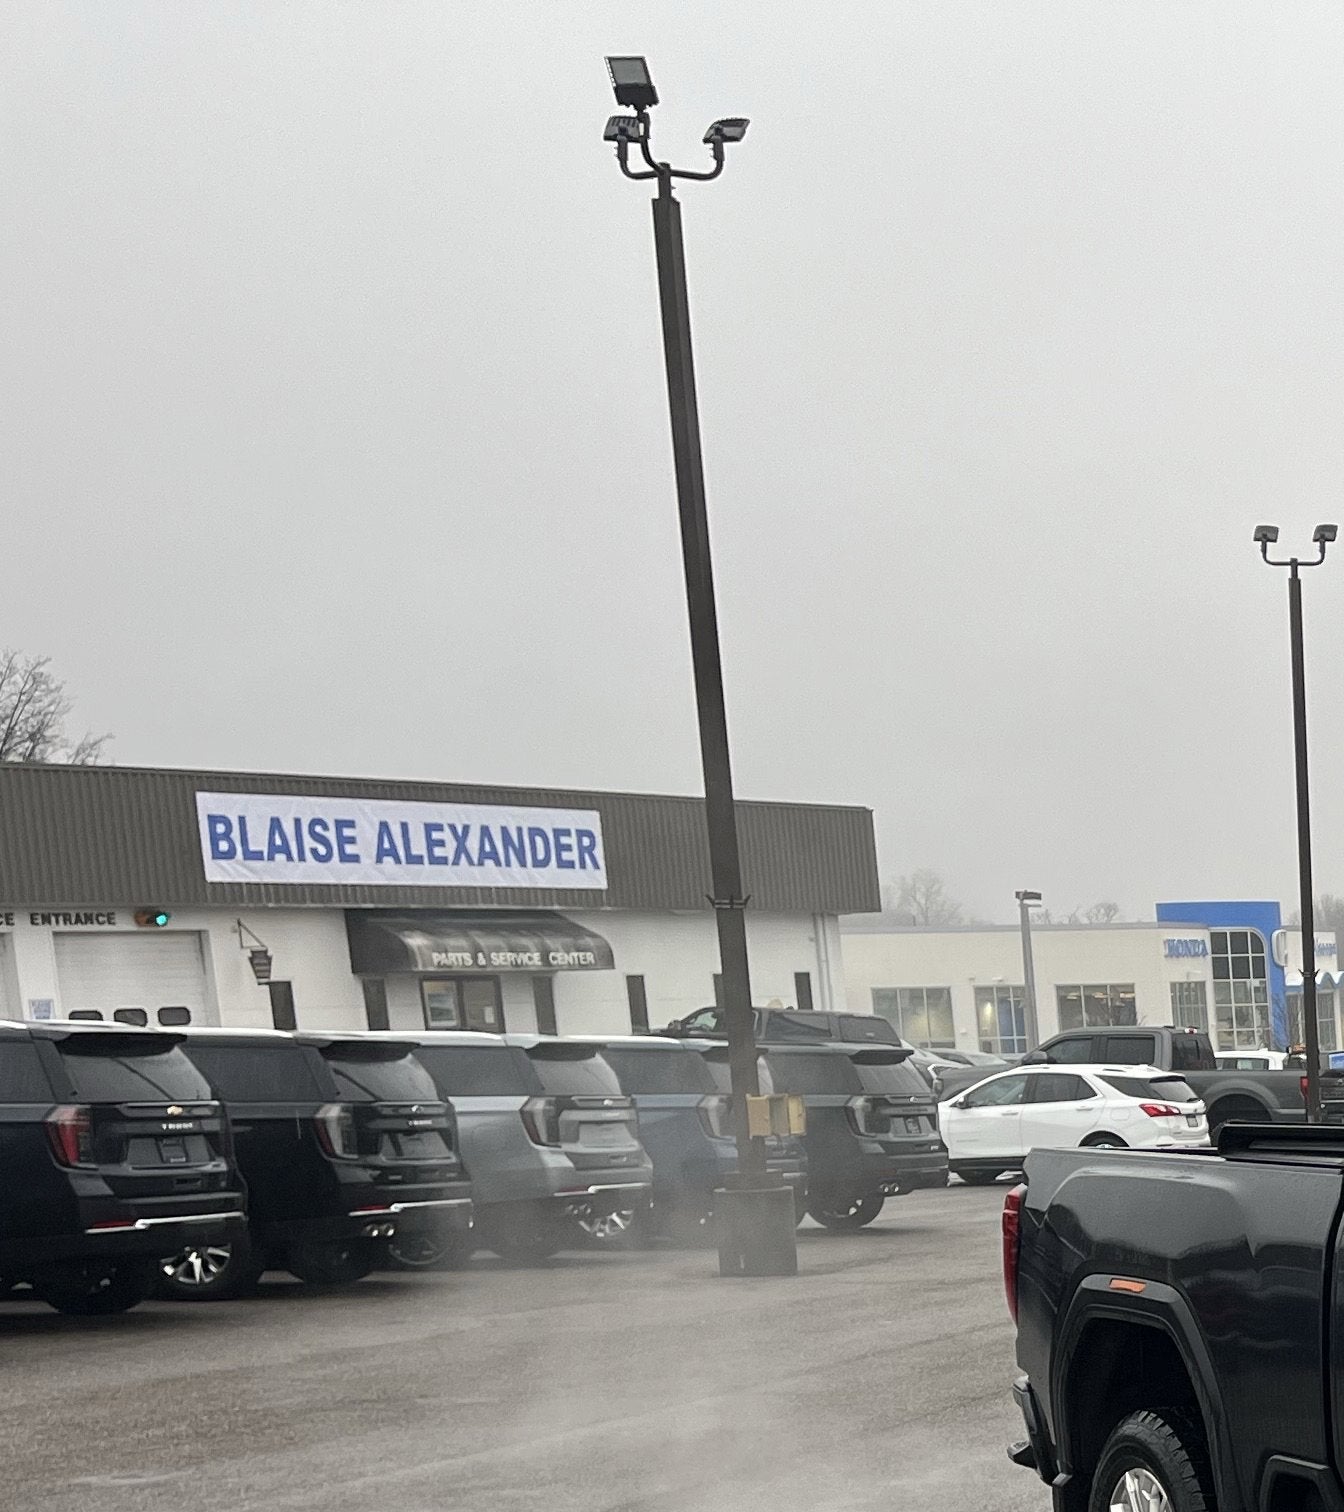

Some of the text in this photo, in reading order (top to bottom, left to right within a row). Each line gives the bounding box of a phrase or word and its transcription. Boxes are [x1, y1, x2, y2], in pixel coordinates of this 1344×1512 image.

[207, 814, 601, 870] BLAISE ALEXANDER
[30, 912, 116, 926] ENTRANCE
[1163, 938, 1209, 958] HONDA
[432, 951, 596, 967] PARTS & SERVICE CENTER
